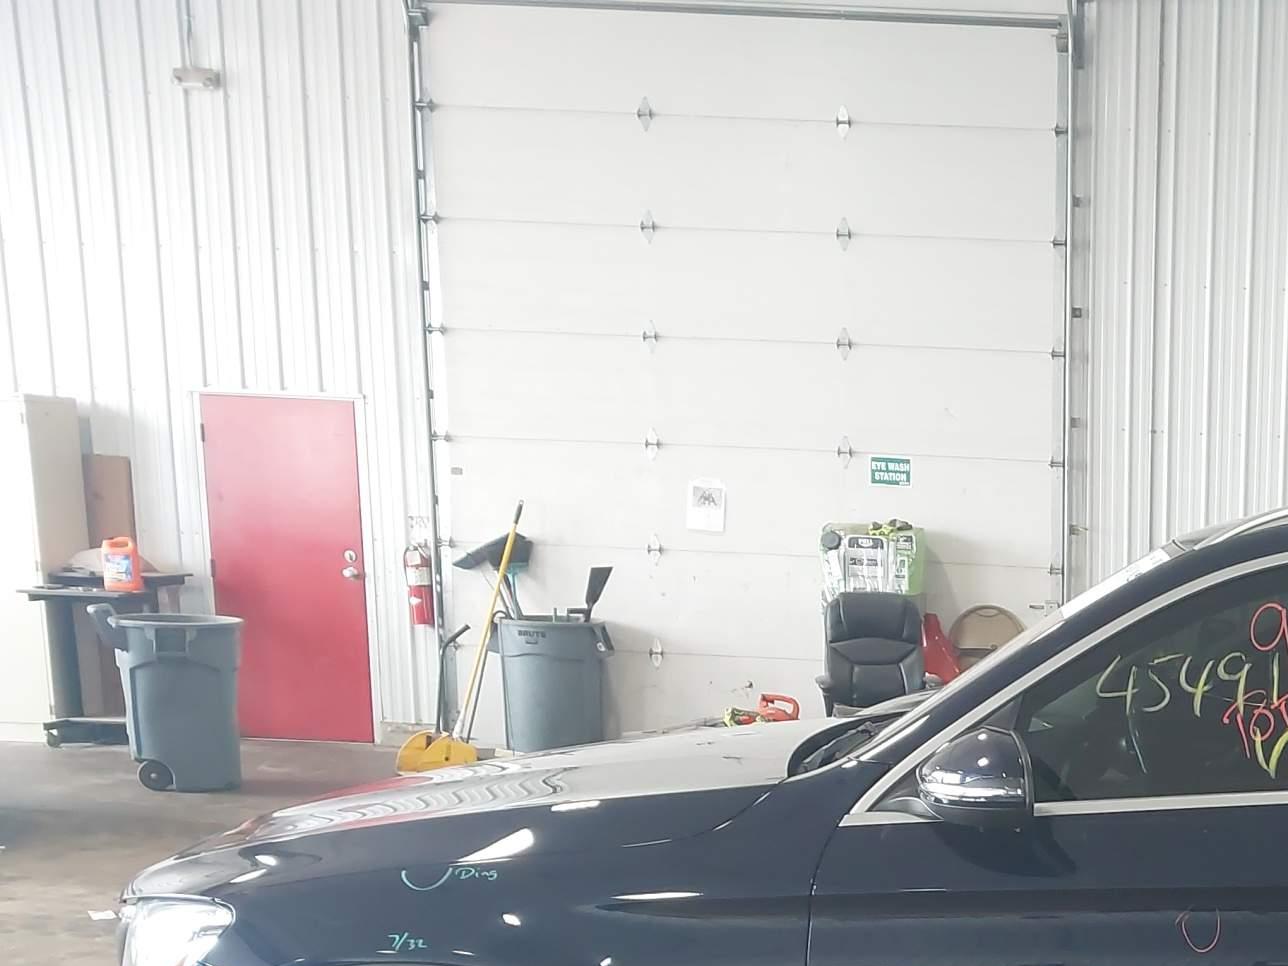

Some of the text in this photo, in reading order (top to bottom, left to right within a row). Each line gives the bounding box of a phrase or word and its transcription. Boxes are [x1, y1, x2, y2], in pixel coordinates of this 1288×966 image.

[871, 461, 910, 472] EYE WASH
[875, 471, 907, 481] STATION
[387, 932, 428, 951] 7/32
